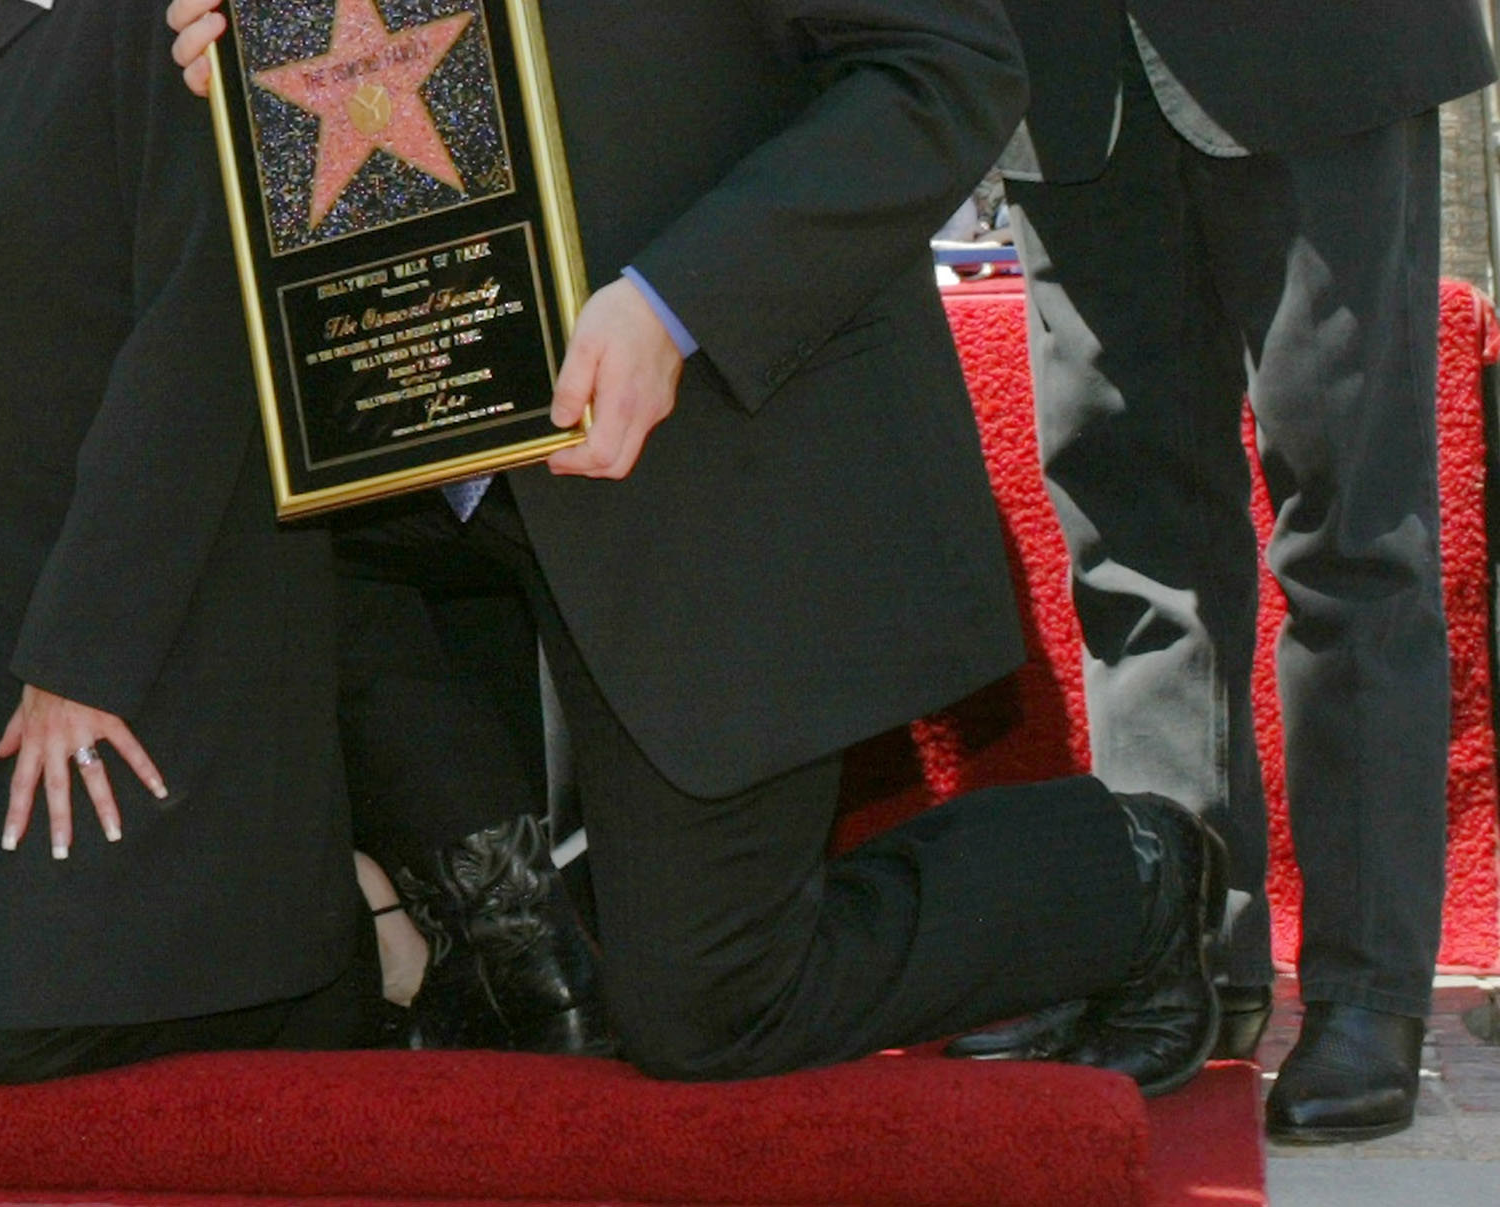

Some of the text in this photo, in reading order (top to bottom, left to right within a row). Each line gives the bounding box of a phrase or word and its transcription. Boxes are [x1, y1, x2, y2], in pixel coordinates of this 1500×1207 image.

[317, 269, 388, 300] HOLLYWOOD
[393, 257, 429, 279] WALK
[323, 276, 500, 340] The Osmond Family
